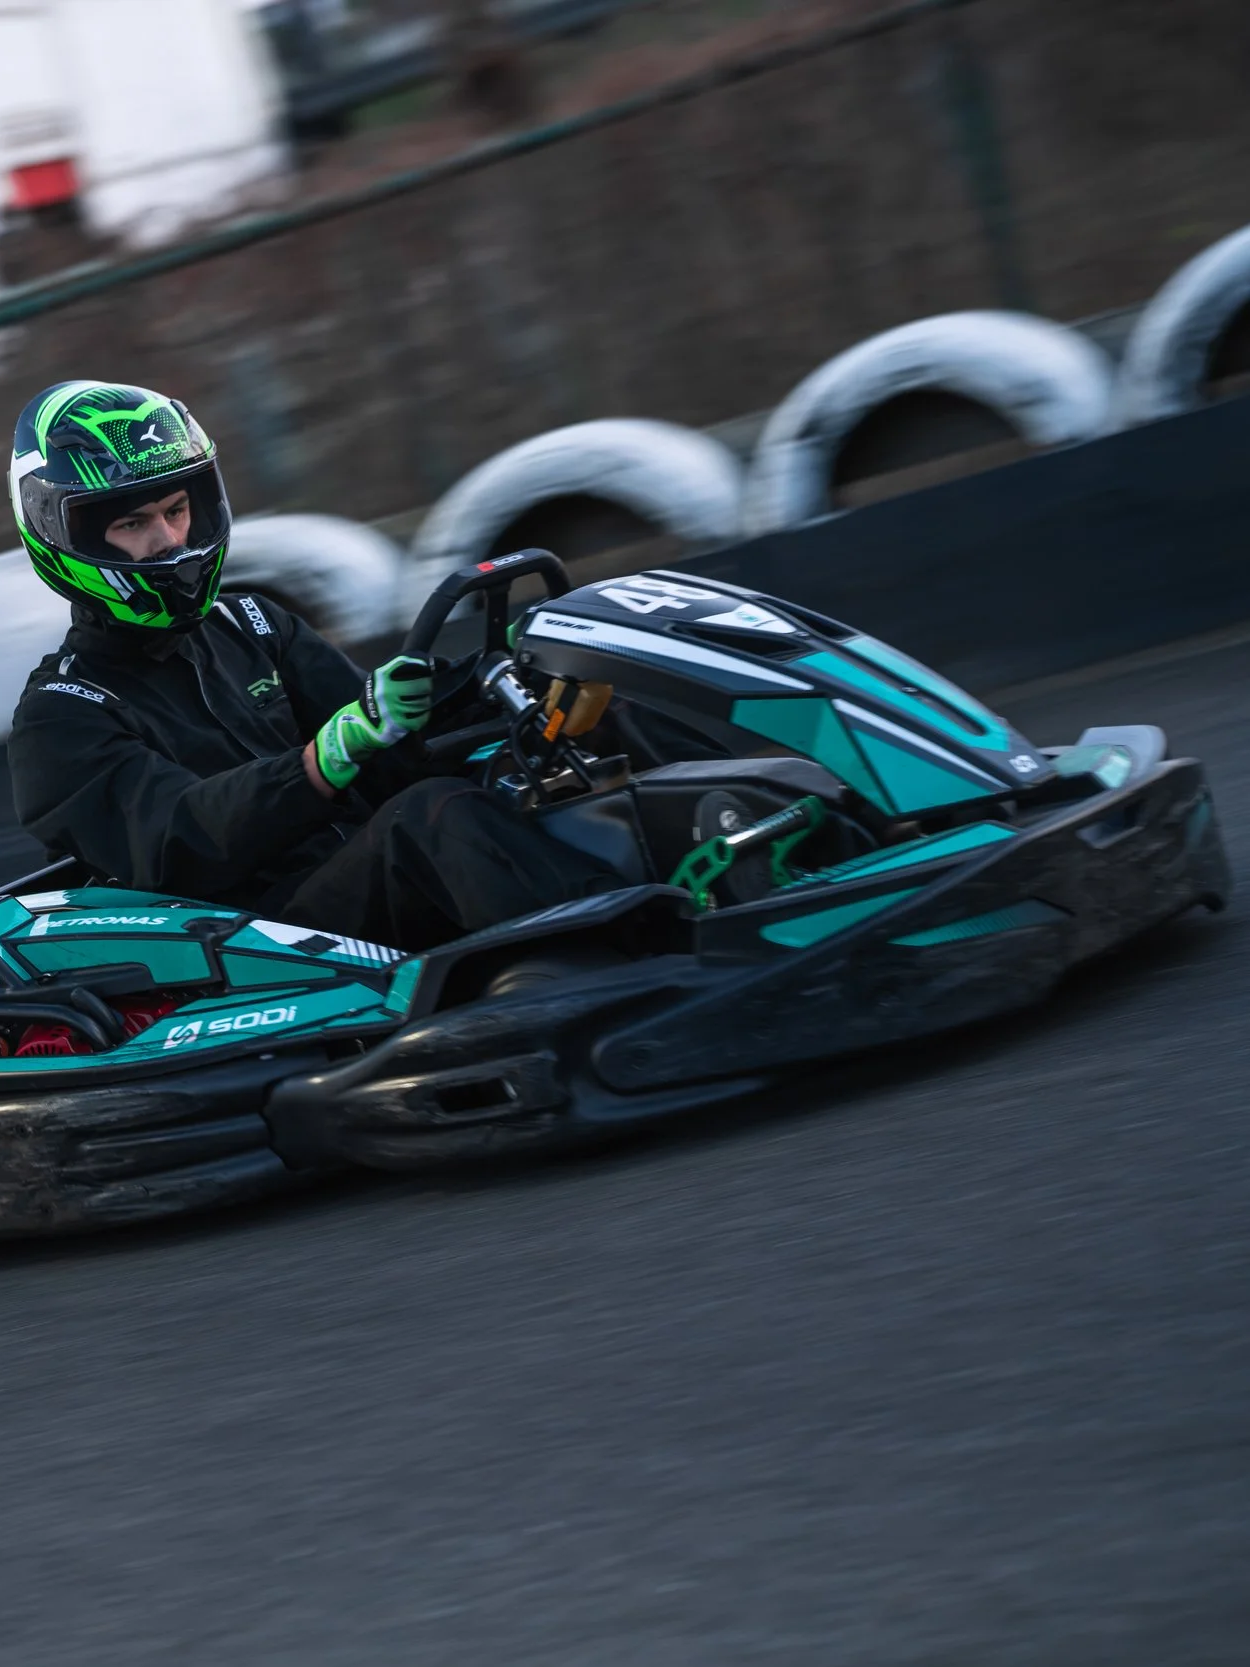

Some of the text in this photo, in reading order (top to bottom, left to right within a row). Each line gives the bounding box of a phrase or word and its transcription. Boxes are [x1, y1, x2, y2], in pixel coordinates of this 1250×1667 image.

[127, 440, 188, 463] karttech
[597, 579, 722, 614] 48
[239, 597, 271, 635] sparco
[42, 683, 106, 703] sparco
